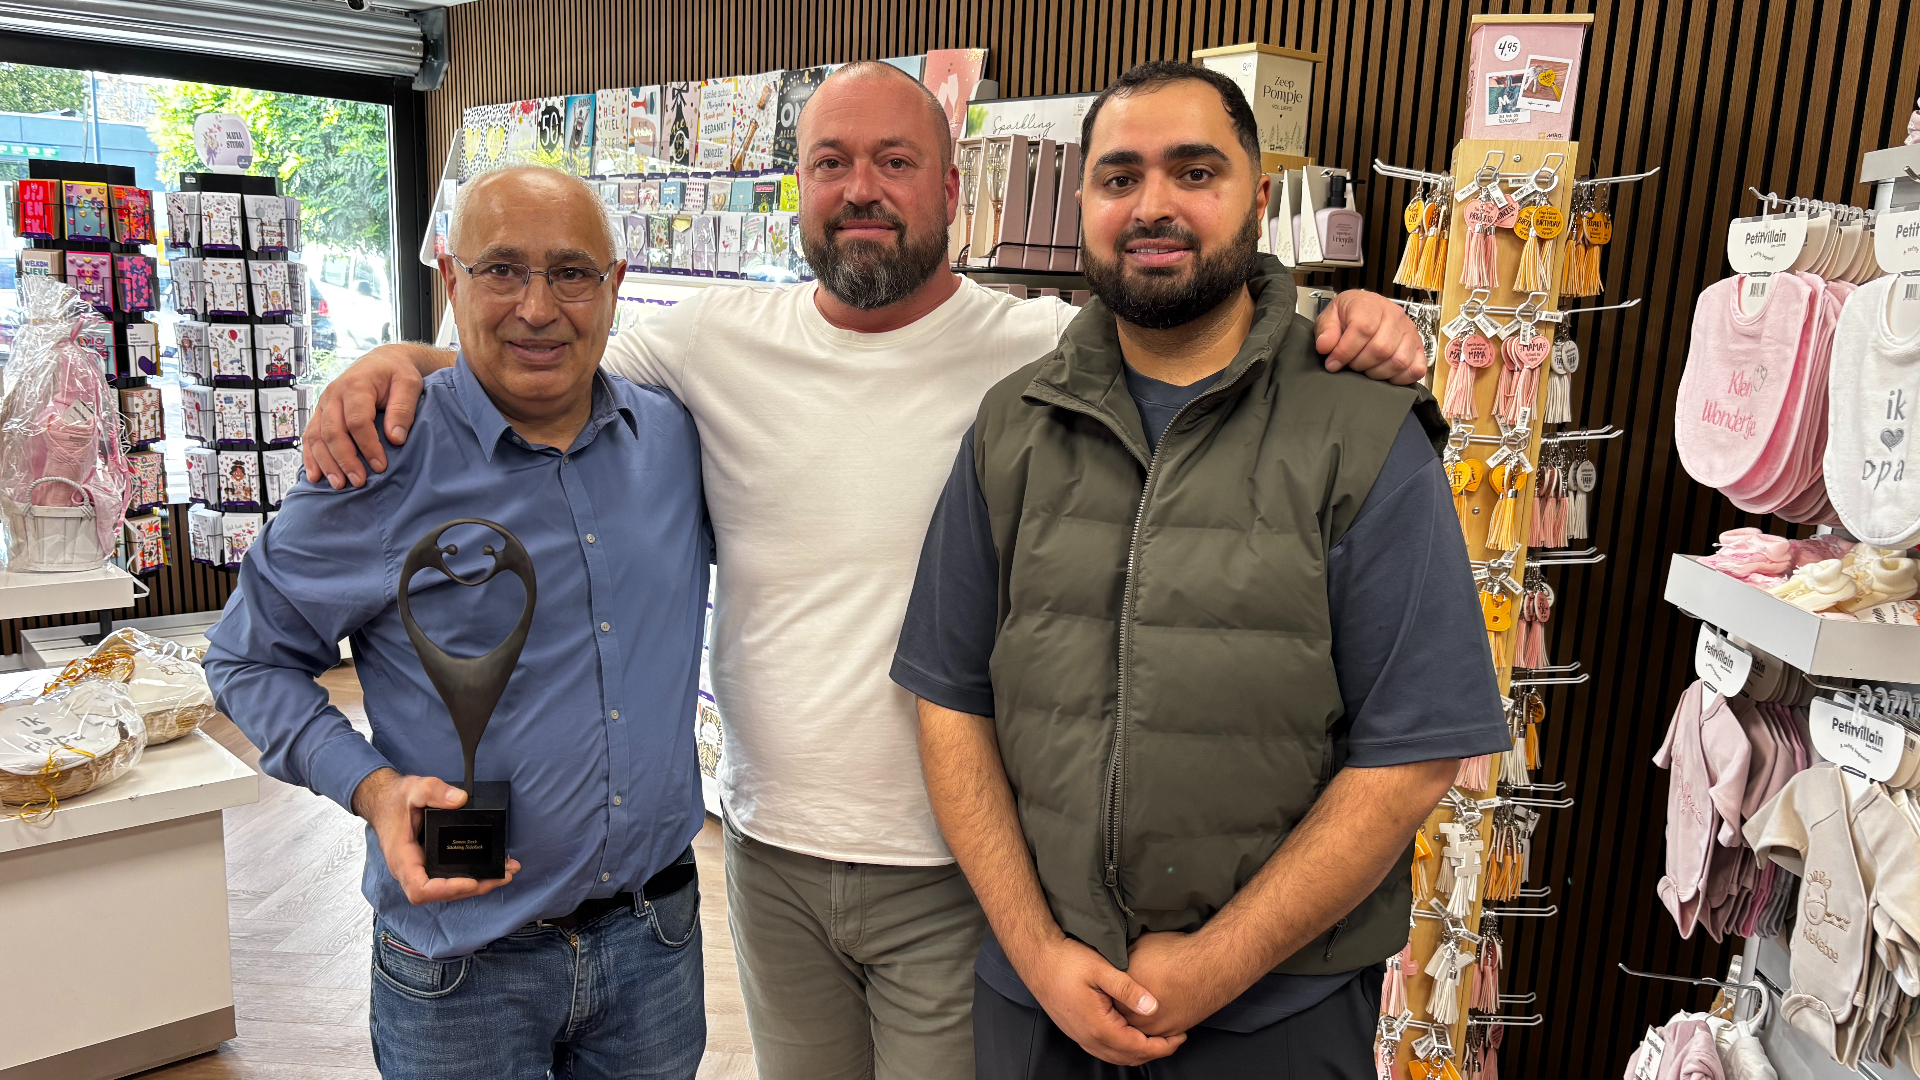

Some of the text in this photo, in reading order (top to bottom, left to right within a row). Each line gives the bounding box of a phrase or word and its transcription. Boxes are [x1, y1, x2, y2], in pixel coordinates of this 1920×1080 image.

[1498, 41, 1518, 56] 4,95
[1274, 76, 1295, 90] Zeep
[1263, 85, 1303, 104] Pompje
[604, 105, 619, 117] HEEL
[541, 112, 559, 146] 50
[604, 119, 619, 131] VEEL
[705, 122, 727, 134] BEDANKT
[993, 114, 1056, 140] Sparkling
[27, 201, 43, 216] EN
[1536, 219, 1560, 228] BIRTHDAY
[25, 260, 49, 268] WELKOM
[77, 268, 100, 279] KUS
[1523, 342, 1544, 352] MAMA
[1469, 351, 1486, 360] MAMA
[1887, 389, 1907, 420] ik
